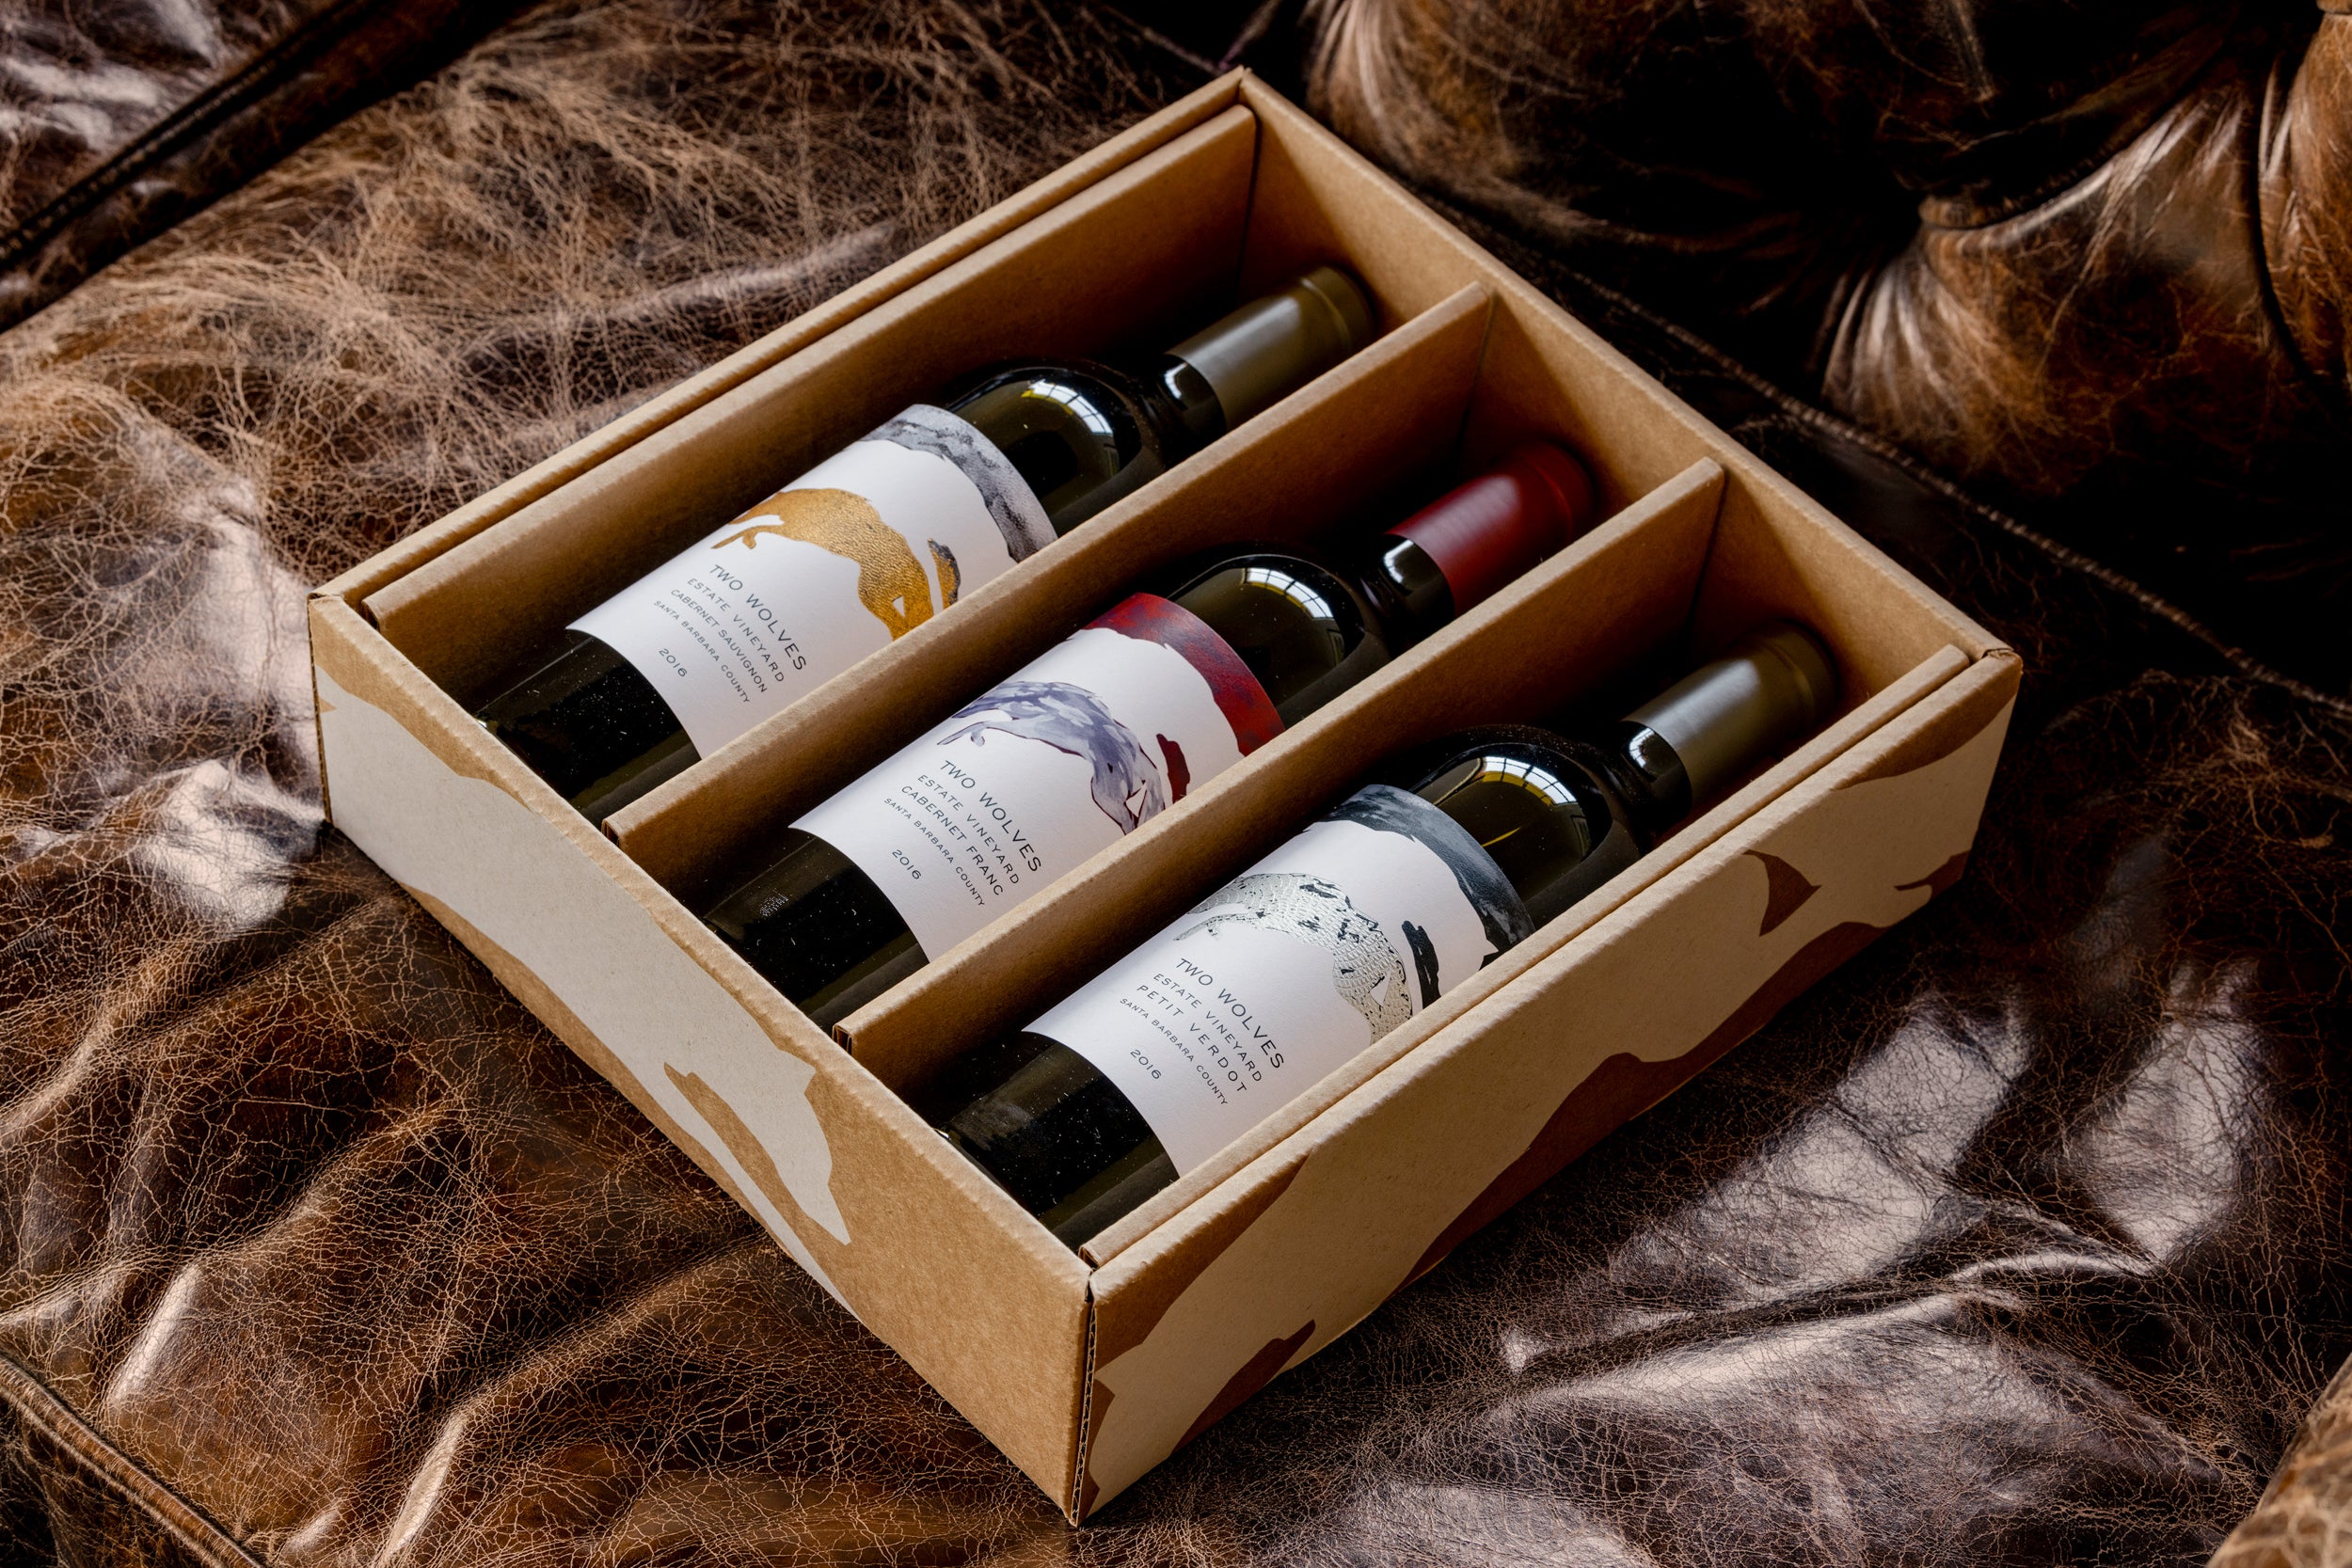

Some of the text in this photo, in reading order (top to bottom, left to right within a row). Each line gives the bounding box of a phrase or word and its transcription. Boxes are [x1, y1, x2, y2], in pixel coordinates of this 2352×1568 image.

[653, 600, 751, 704] SANTA BARBARA COUNTY
[659, 648, 688, 677] 2016
[670, 589, 768, 693] CABERNET SAUVIGNON
[687, 578, 785, 683] ESTATE VINEYARD
[709, 564, 807, 671] TWO WOLVES
[883, 798, 986, 907] SANTA BARBARA COUNTY
[891, 849, 922, 879] 2016
[901, 785, 1004, 895] CABERNET FRANC
[917, 774, 1020, 884] ESTATE VINEYARD
[940, 760, 1041, 872] TWO WOLVES
[1120, 998, 1229, 1105] SANTA BARBARA COUNTY
[1129, 1049, 1162, 1080] 2016
[1136, 985, 1248, 1092] PETIT VERDOT
[1152, 974, 1263, 1082] ESTATE VINEYARD
[1175, 958, 1284, 1069] TWO WOLVES
